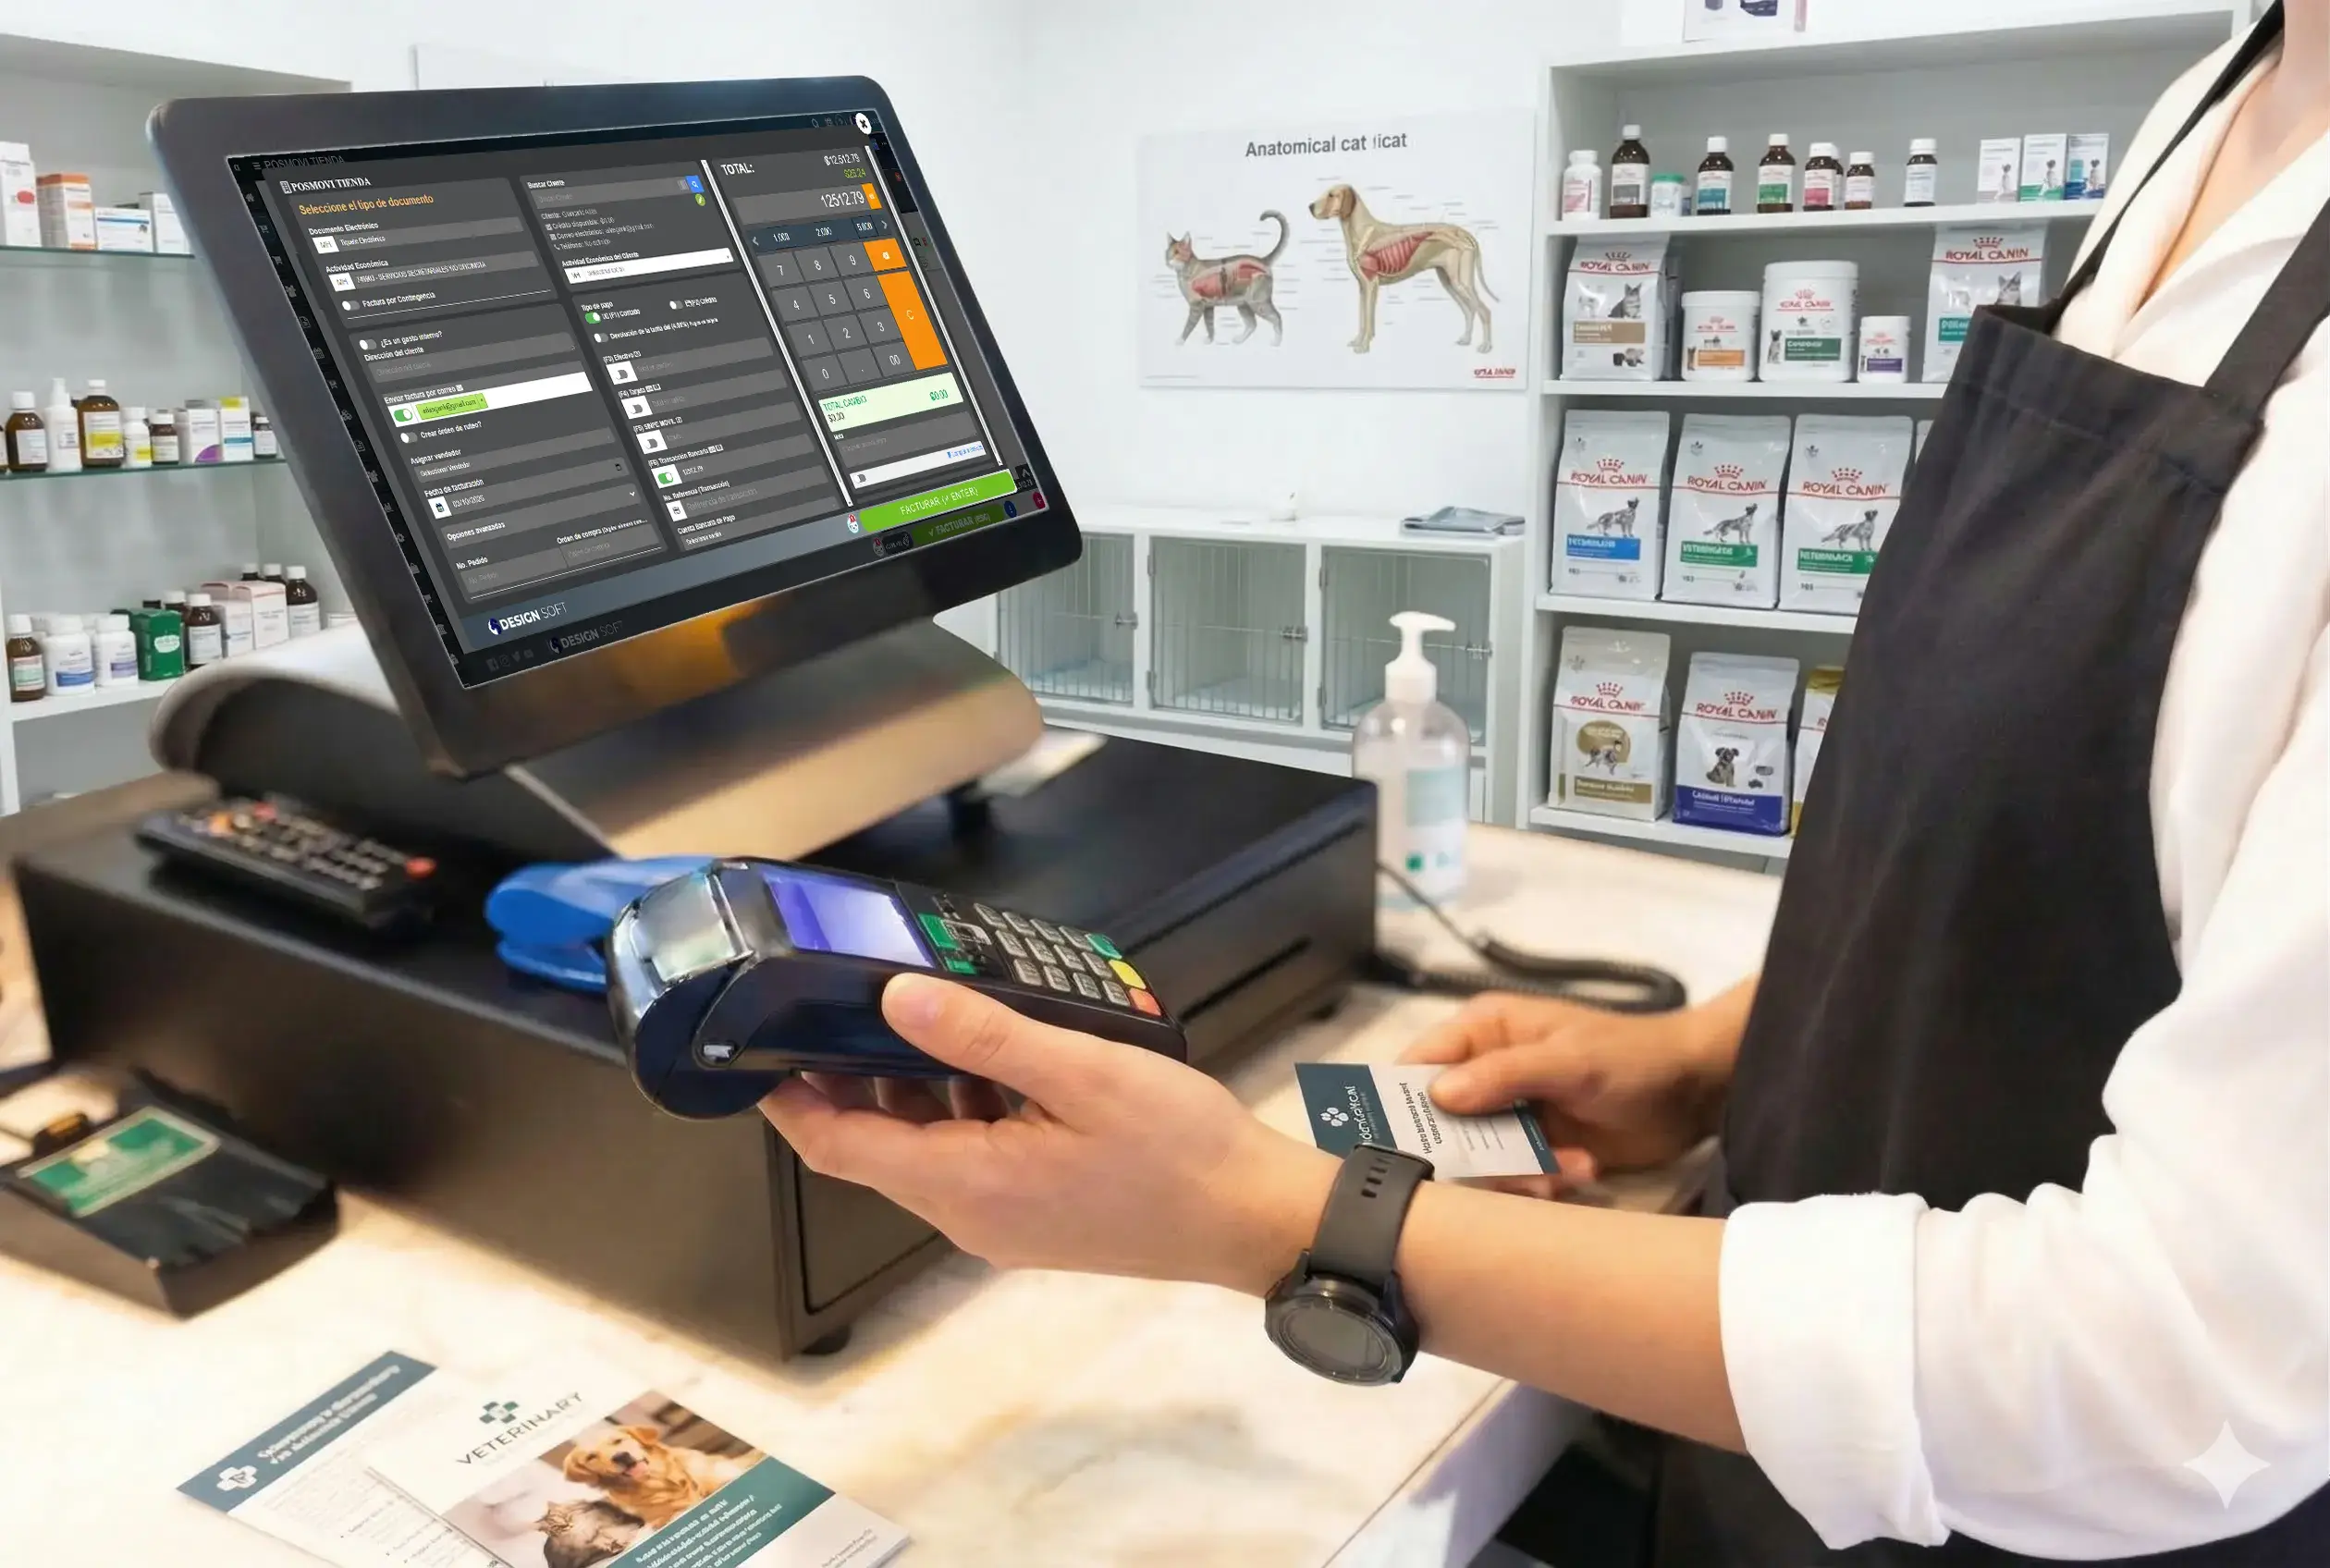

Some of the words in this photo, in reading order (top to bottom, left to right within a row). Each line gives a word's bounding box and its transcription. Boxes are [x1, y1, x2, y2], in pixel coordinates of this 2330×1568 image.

[1245, 135, 1336, 157] Anatomical
[1341, 135, 1367, 151] cat
[721, 164, 755, 176] TOTAL:
[290, 179, 336, 192] POSMOVI
[336, 177, 372, 188] TIENDA
[527, 180, 546, 189] Buscar
[546, 178, 565, 188] Cliente
[299, 202, 348, 215] Seleccione
[349, 201, 358, 211] el
[358, 199, 375, 211] tipo
[375, 198, 387, 208] de
[387, 193, 434, 206] documento
[820, 190, 865, 208] 12512.79
[308, 225, 344, 236] Documento
[344, 222, 379, 232] Electrónico
[561, 257, 586, 267] Actividad
[585, 254, 613, 264] Económica
[621, 251, 640, 260] Cliente
[849, 254, 856, 266] 9
[1945, 249, 1984, 262] ROYAL
[1988, 247, 2030, 261] CANIN
[325, 263, 355, 274] Actividad
[355, 259, 389, 270] Económica
[777, 264, 784, 276] 7
[815, 260, 822, 271] 8
[1580, 261, 1613, 272] ROYAL
[362, 298, 386, 309] Factura
[386, 296, 398, 307] por
[397, 291, 435, 303] Contingencia
[828, 294, 836, 305] 5
[864, 288, 871, 300] 6
[582, 303, 593, 312] Tipo
[600, 301, 614, 310] pago
[793, 300, 800, 311] 4
[842, 327, 851, 338] 2
[877, 321, 885, 333] 3
[380, 338, 393, 349] ¿Es
[393, 337, 401, 346] un
[401, 335, 419, 345] gasto
[419, 330, 443, 340] interno?
[609, 330, 639, 340] Devolución
[808, 334, 815, 345] 1
[363, 350, 395, 361] Dirección
[395, 349, 404, 358] del
[403, 346, 424, 356] cliente
[822, 368, 829, 380] 0
[384, 394, 404, 405] Enviar
[403, 391, 426, 401] factura
[425, 389, 436, 398] por
[436, 386, 457, 396] correo
[420, 429, 437, 439] Crear
[455, 424, 463, 433] de
[411, 454, 434, 465] Asignar
[434, 448, 461, 460] vendedor
[1571, 471, 1606, 484] ROYAL
[1609, 473, 1649, 484] CANIN
[1686, 475, 1725, 491] ROYAL
[1727, 479, 1768, 491] CANIN
[423, 486, 442, 498] Fecha
[442, 484, 451, 494] de
[451, 478, 484, 491] facturación
[1803, 482, 1843, 496] ROYAL
[1846, 484, 1889, 496] CANIN
[900, 496, 940, 516] FACTURAR
[447, 528, 474, 541] Opciones
[474, 521, 506, 533] avanzadas
[935, 516, 974, 535] FACTURAR
[557, 535, 574, 545] Orden
[574, 533, 582, 541] de
[456, 560, 466, 570] No.
[467, 555, 488, 567] Pedido
[499, 609, 541, 631] DESIGN
[541, 602, 568, 619] SOFT
[560, 628, 600, 649] DESIGN
[600, 620, 625, 636] SOFT
[1570, 695, 1606, 711] ROYAL
[1696, 703, 1736, 717] ROYAL
[1738, 708, 1778, 720] CANIN
[455, 1390, 583, 1465] VETERINARY
